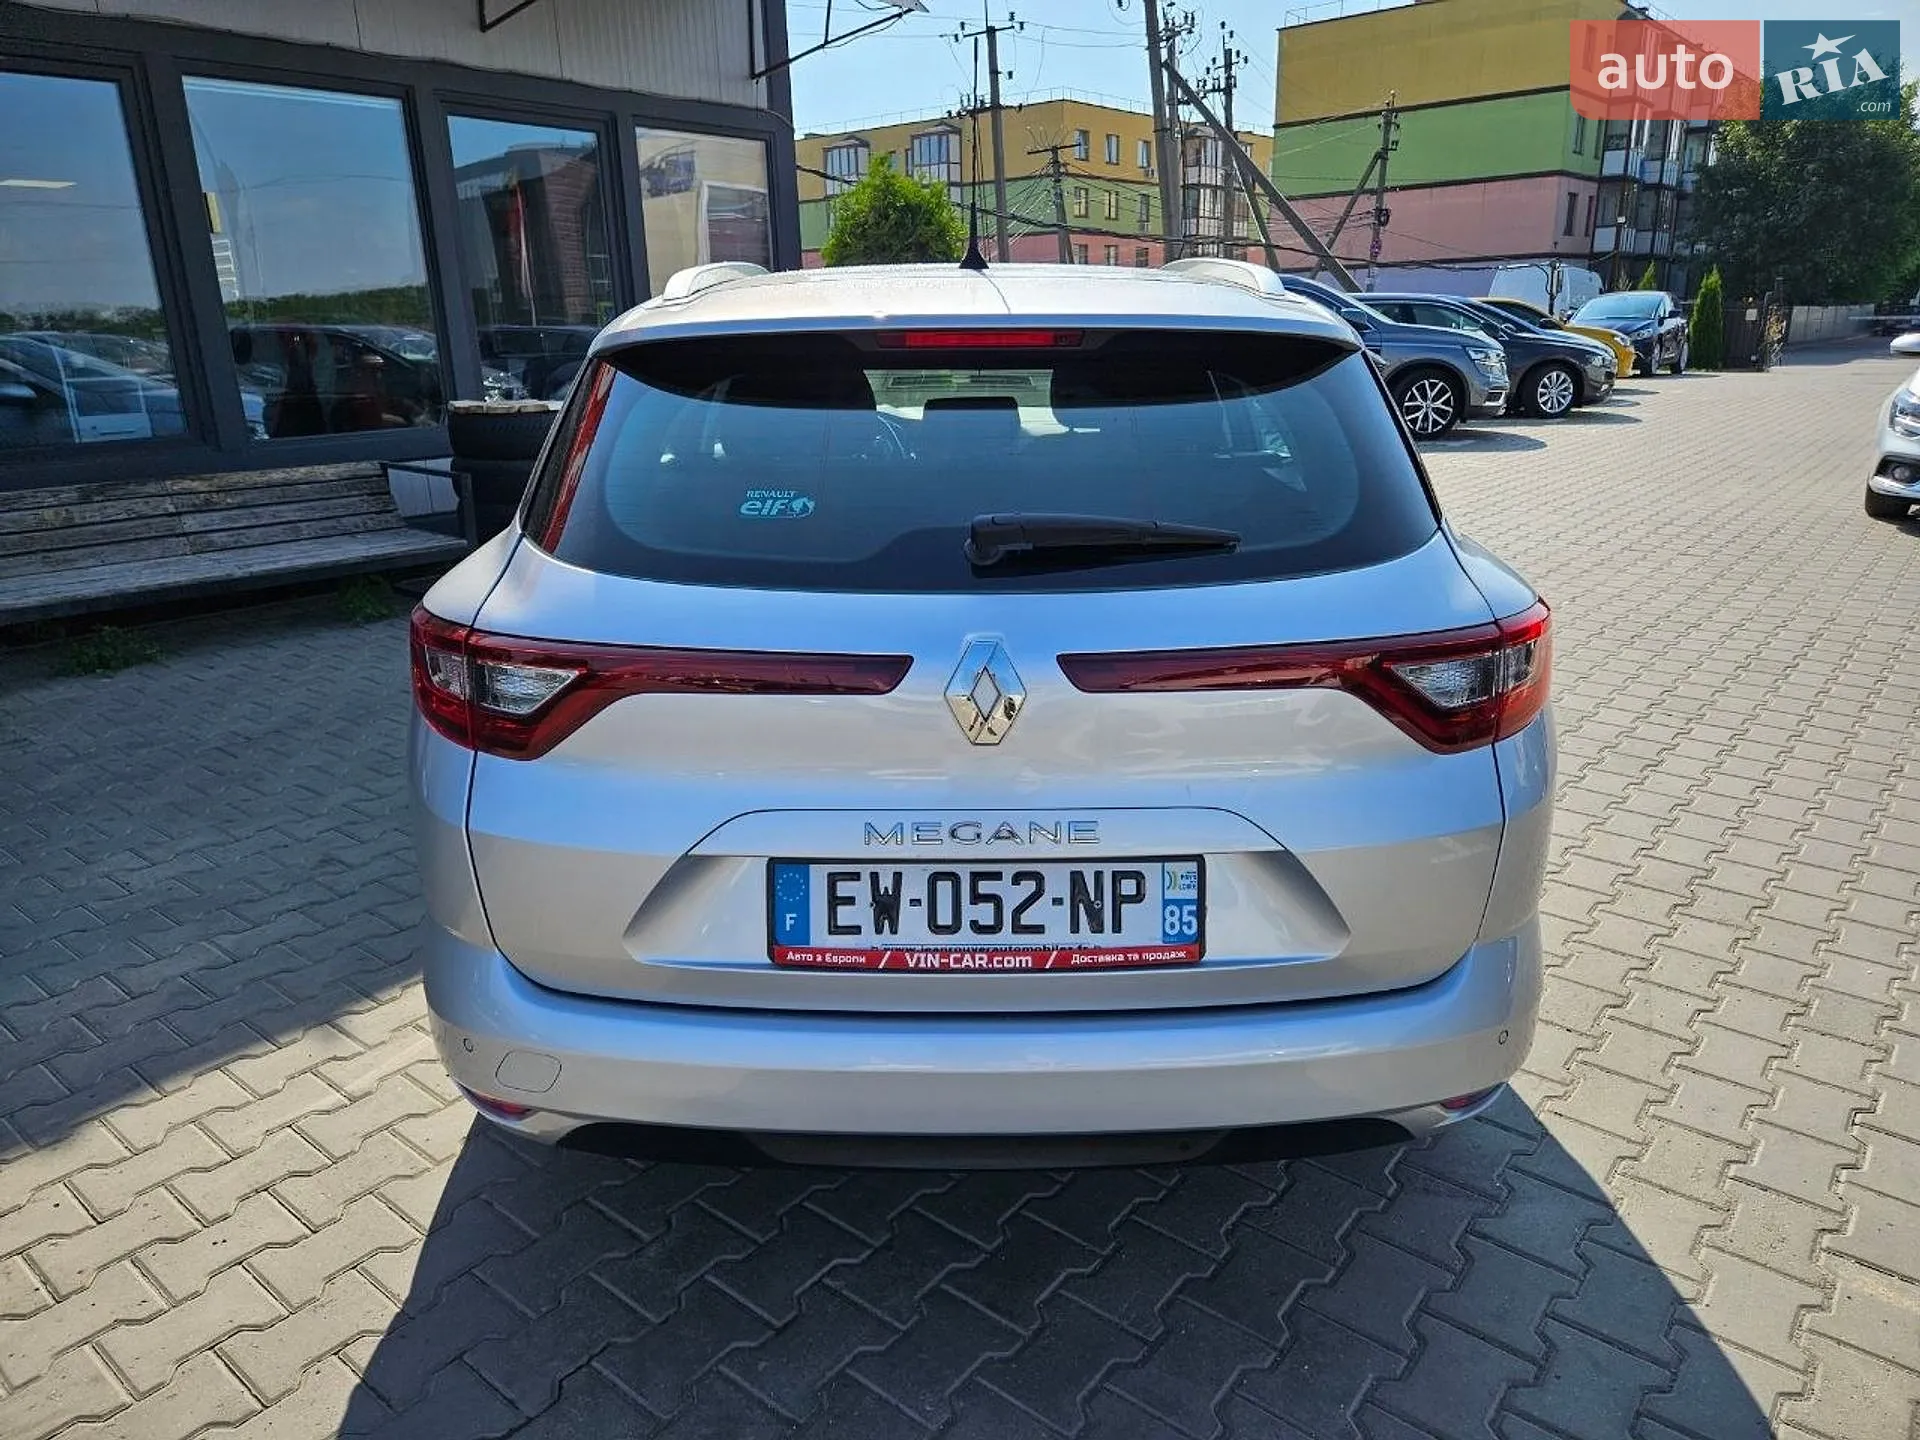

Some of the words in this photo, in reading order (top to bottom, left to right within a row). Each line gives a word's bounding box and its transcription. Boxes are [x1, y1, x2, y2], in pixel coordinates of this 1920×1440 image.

[746, 490, 796, 498] RENAULT
[740, 499, 789, 516] elf
[863, 820, 1101, 845] MEGANE
[826, 869, 1146, 936] EW-052-NP
[784, 913, 797, 931] F
[1164, 904, 1198, 936] 85
[786, 951, 813, 962] Авто
[904, 953, 1032, 969] VIN-CAR.com
[1071, 953, 1125, 965] Доставка
[1127, 954, 1140, 962] та
[1142, 950, 1187, 962] продаж
